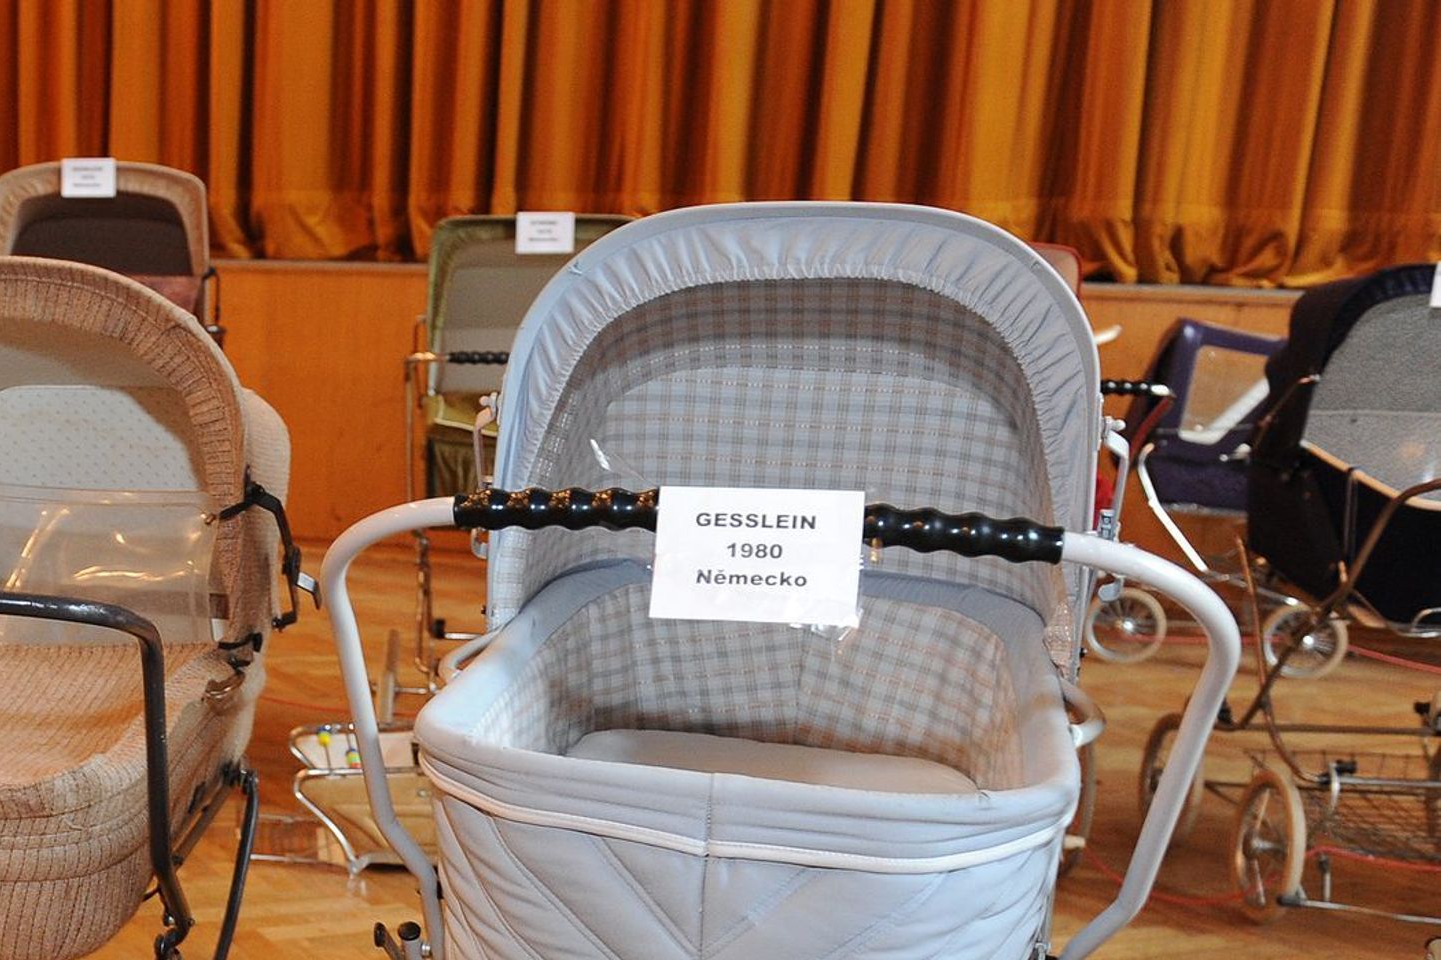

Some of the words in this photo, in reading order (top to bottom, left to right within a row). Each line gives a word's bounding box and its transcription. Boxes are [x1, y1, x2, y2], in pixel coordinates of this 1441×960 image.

[696, 512, 817, 530] GESSLEIN
[726, 542, 783, 559] 1980
[695, 569, 808, 588] Německo
